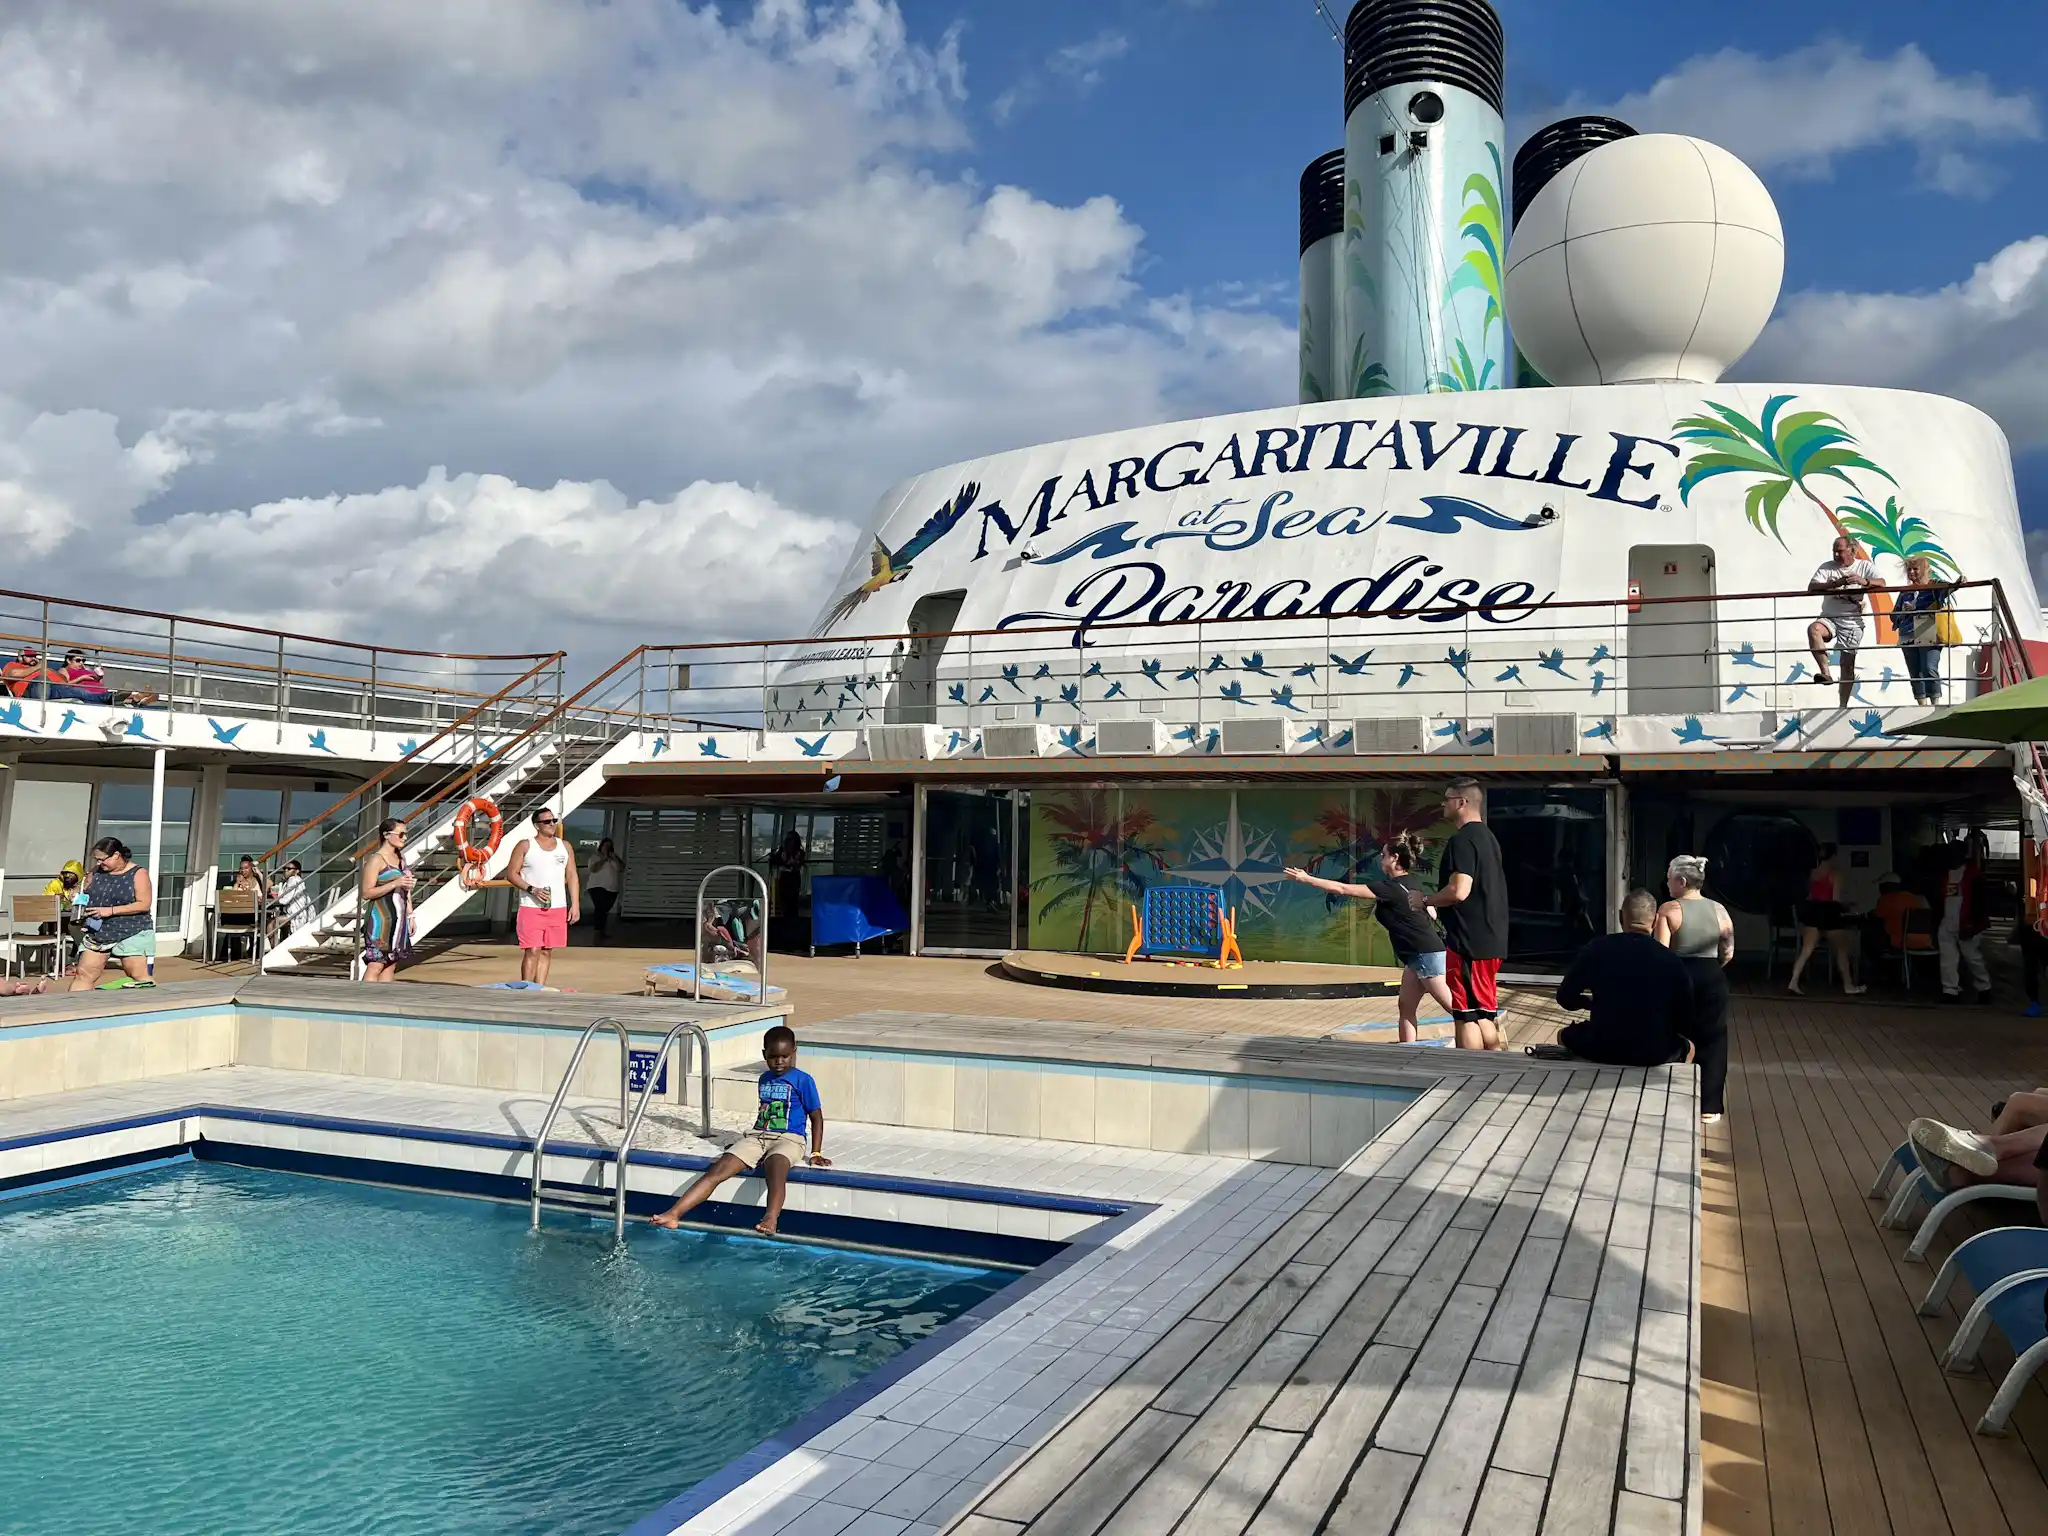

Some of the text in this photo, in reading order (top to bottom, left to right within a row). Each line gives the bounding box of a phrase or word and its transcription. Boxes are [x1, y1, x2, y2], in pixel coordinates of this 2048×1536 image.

[970, 419, 1681, 562] MARGARITAVILLE
[1144, 490, 1389, 552] at Sea
[996, 554, 1556, 649] Paradise
[629, 1060, 639, 1069] m
[629, 1069, 637, 1080] ft
